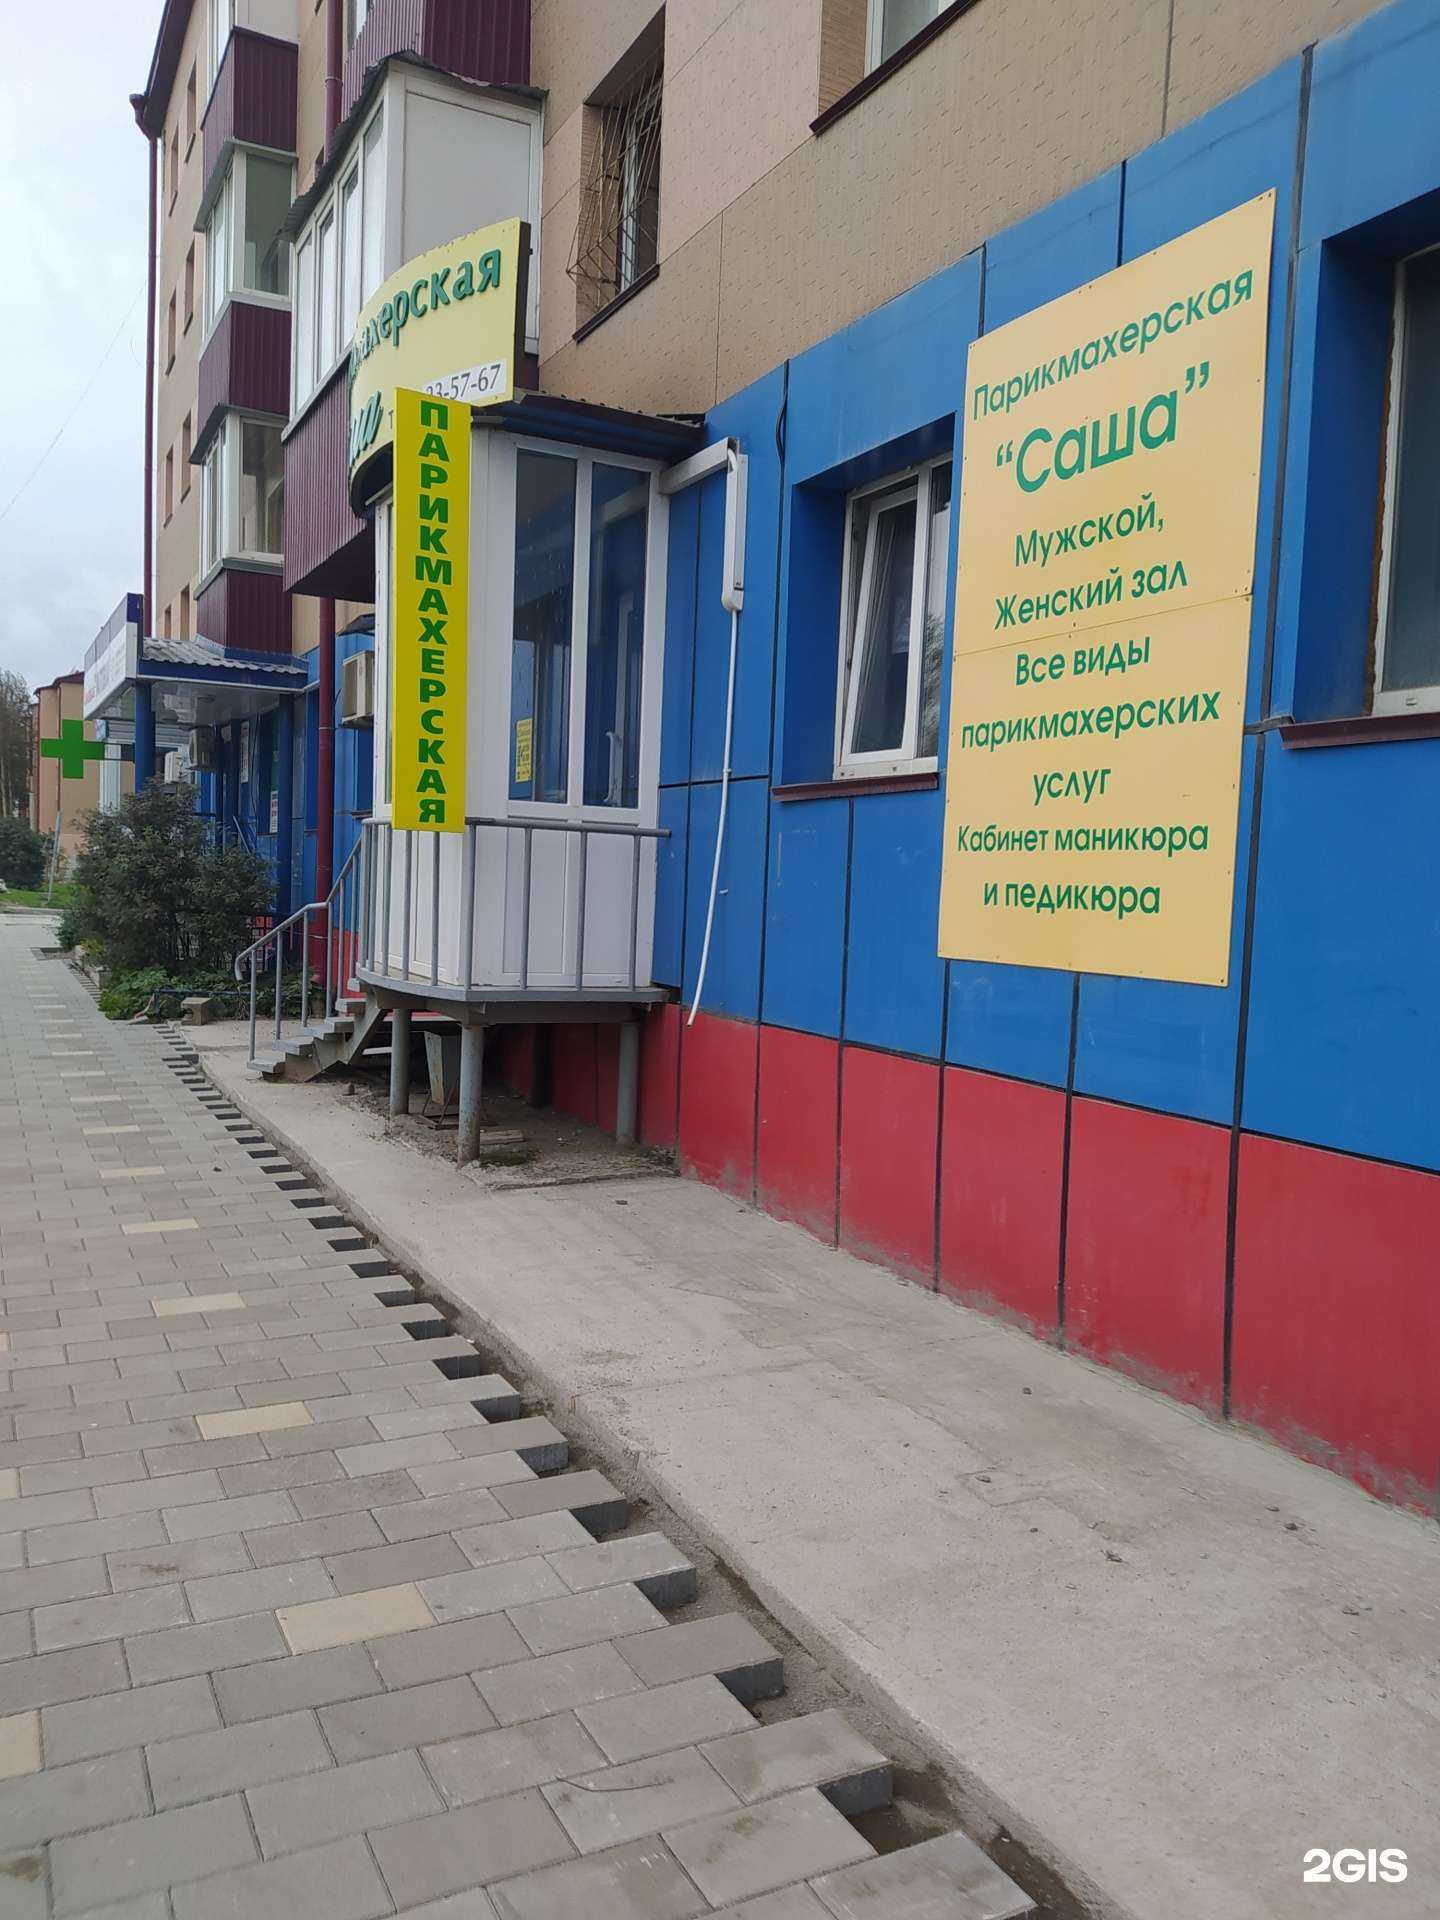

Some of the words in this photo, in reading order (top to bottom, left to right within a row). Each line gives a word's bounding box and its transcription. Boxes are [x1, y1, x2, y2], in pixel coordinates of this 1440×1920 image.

[973, 269, 1254, 420] Парикмахерская
[1015, 491, 1164, 567] Мужской,
[415, 401, 453, 824] ПАРИКМАХЕРСКАЯ
[994, 568, 1122, 630] Женский
[1130, 560, 1189, 600] зал
[1015, 653, 1066, 687] Все
[1073, 637, 1151, 677] виды
[961, 691, 1222, 752] парикмахерских
[1032, 768, 1112, 806] услуг
[957, 824, 1049, 852] Кабинет
[1054, 824, 1210, 858] маникюра
[983, 883, 999, 906] и
[1005, 883, 1162, 919] педикюра
